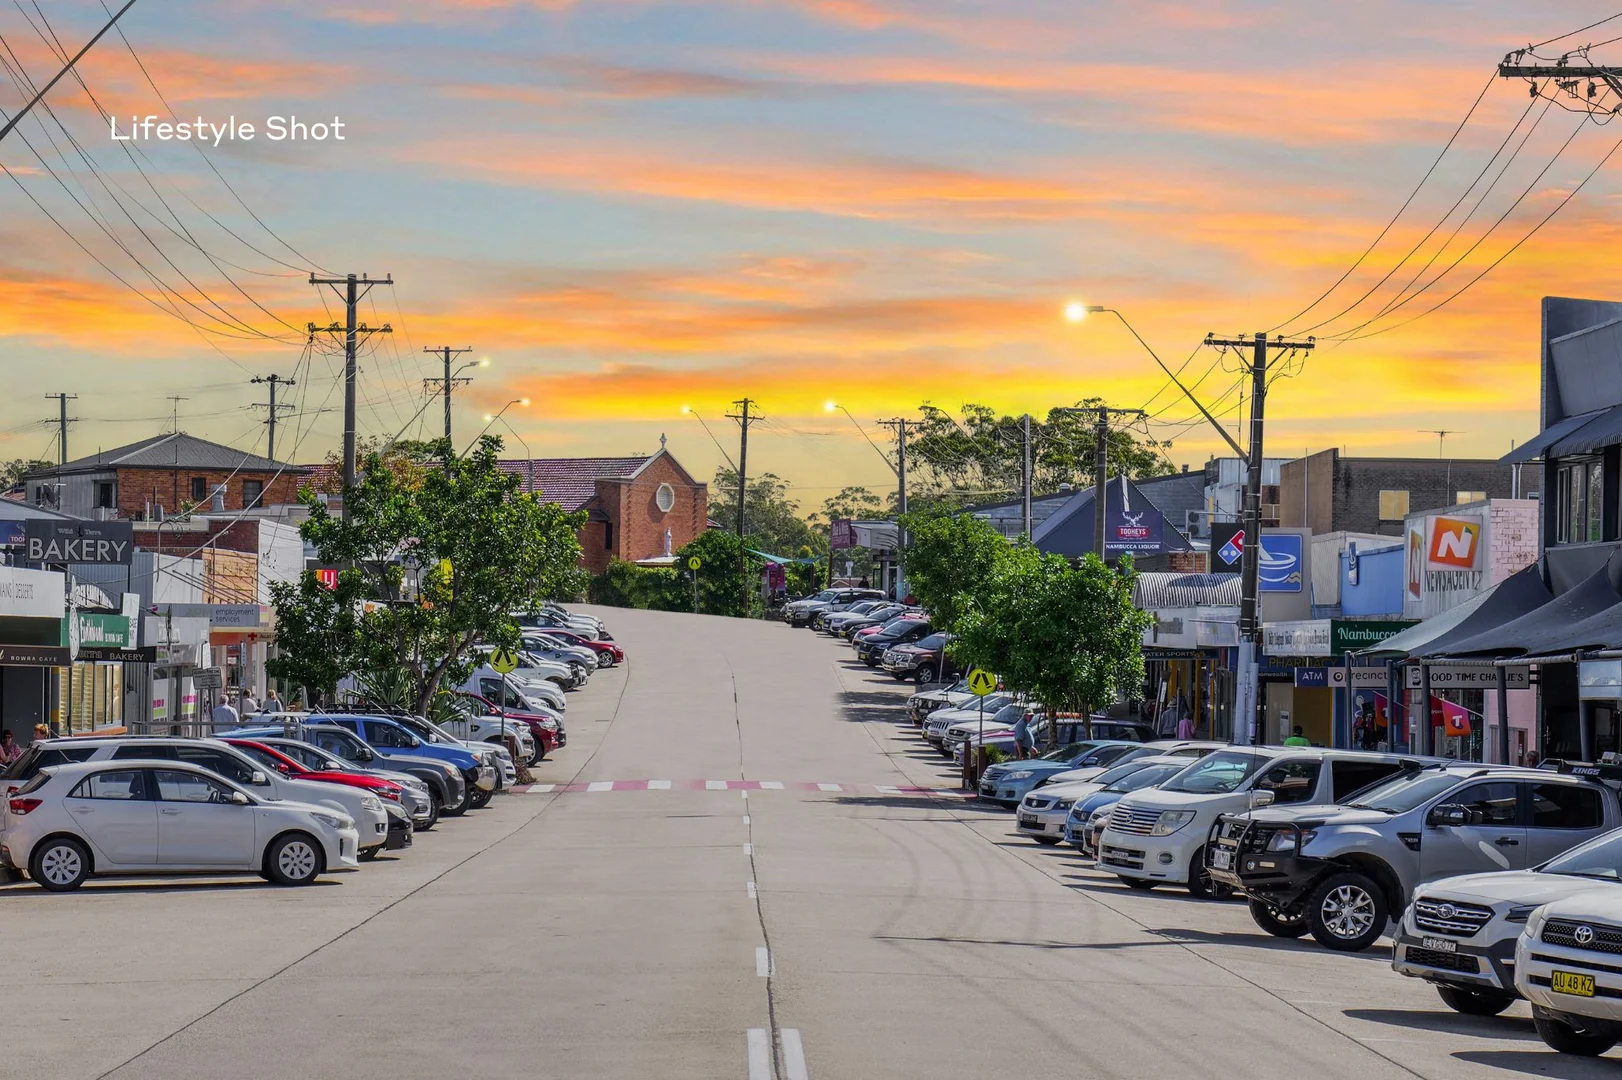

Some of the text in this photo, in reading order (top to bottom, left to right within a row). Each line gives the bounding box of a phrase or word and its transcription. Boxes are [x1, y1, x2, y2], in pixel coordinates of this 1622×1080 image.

[29, 537, 127, 562] BAKERY
[216, 608, 254, 616] employment
[1338, 627, 1396, 640] Nambucca
[109, 652, 145, 660] BAKERY
[1302, 671, 1323, 680] ATM
[1430, 673, 1524, 681] OOD TIME CHAIE'S
[1571, 767, 1600, 775] KINGS
[1554, 972, 1564, 988] AU
[1581, 975, 1592, 992] KZ
